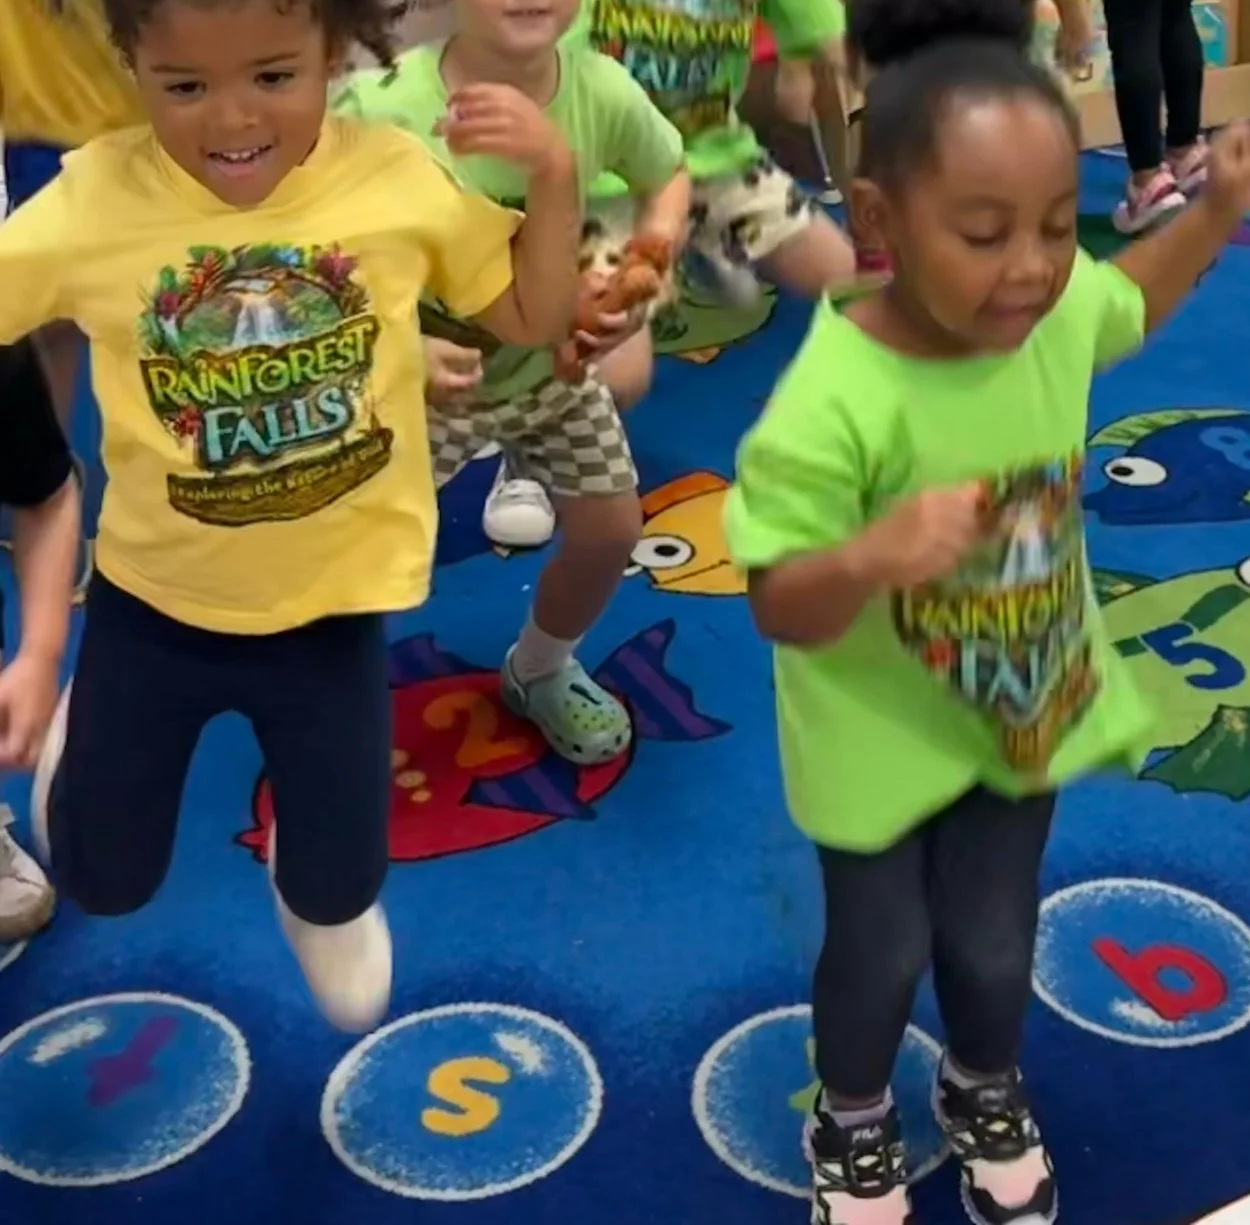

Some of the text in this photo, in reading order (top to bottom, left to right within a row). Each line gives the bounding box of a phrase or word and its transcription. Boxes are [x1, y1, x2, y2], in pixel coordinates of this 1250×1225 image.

[148, 322, 374, 404] RAINFOREST
[203, 385, 348, 463] FALLS
[255, 480, 283, 497] the
[1139, 621, 1246, 690] 5
[422, 690, 530, 769] 2
